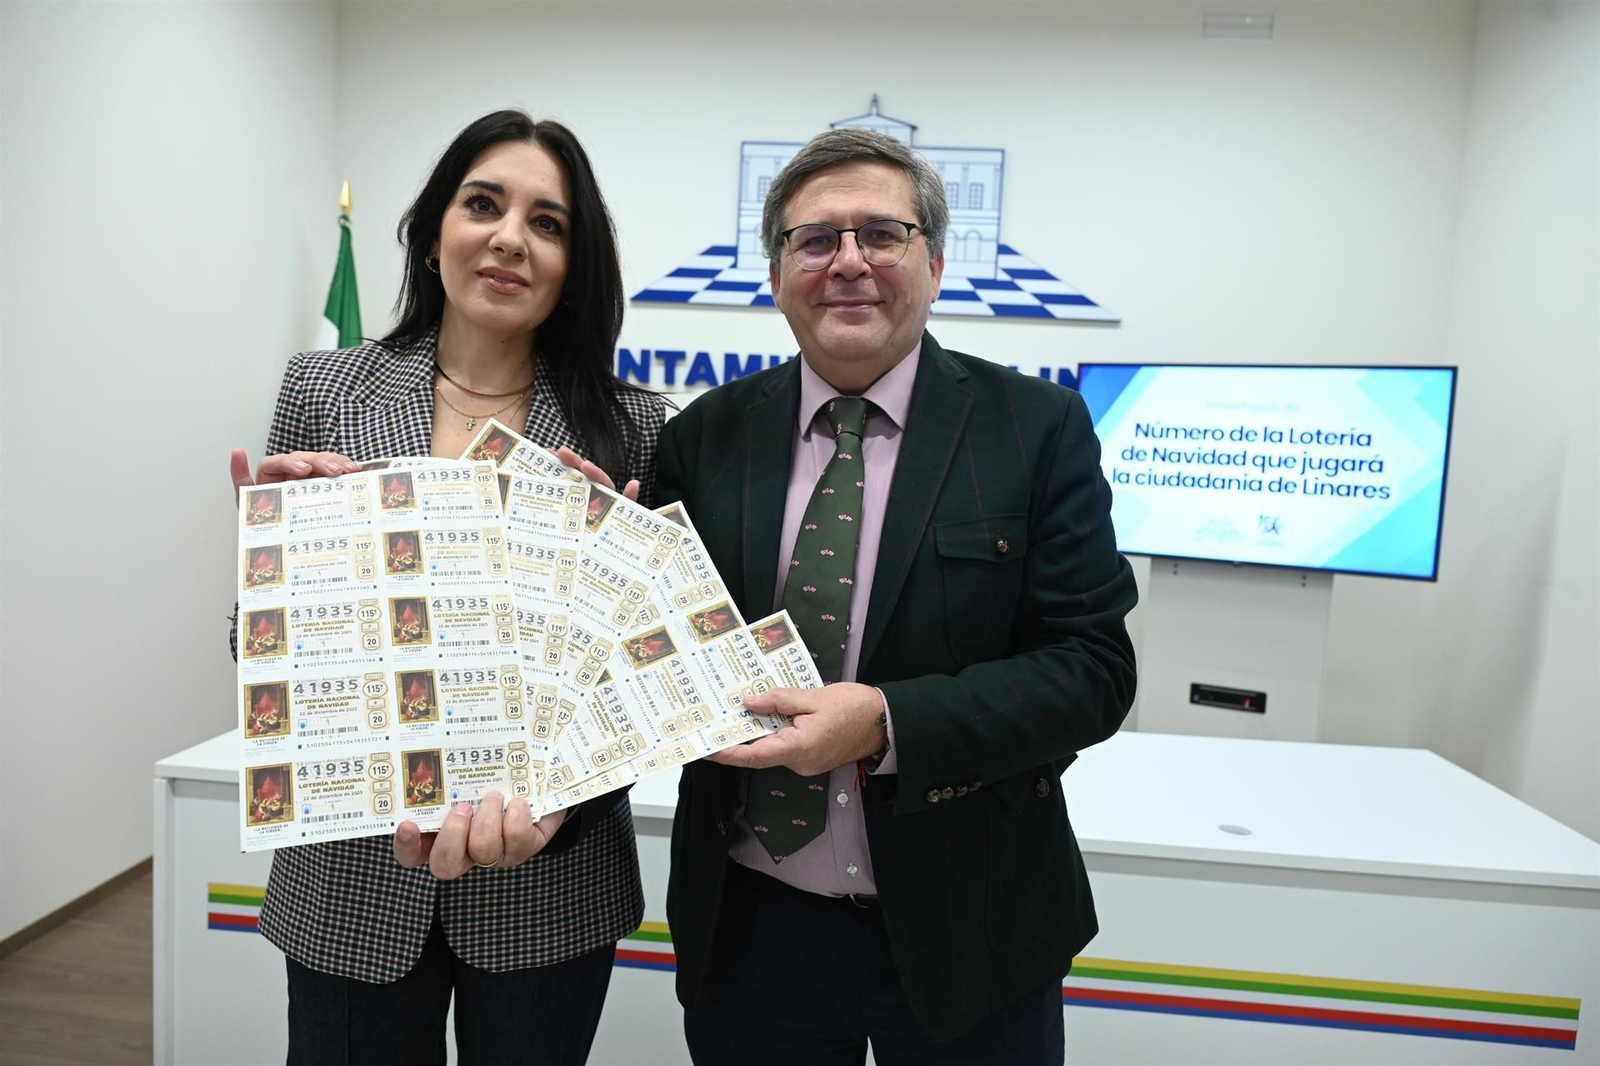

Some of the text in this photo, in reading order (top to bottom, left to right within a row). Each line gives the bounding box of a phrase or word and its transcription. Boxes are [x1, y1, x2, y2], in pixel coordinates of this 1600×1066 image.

[1135, 421, 1372, 446] Número de la Lotería
[518, 447, 563, 476] 41935
[1121, 446, 1384, 477] de Navidad que jugará
[418, 471, 470, 480] 41935
[287, 482, 344, 495] 41935
[515, 481, 564, 497] 41935
[1112, 467, 1130, 484] la
[1268, 477, 1297, 494] de
[1303, 477, 1390, 499] Linares
[617, 506, 661, 533] 41935
[425, 532, 478, 541] 41935
[288, 539, 347, 553] 41935
[683, 537, 710, 579] 41935
[582, 559, 628, 587] 41935
[432, 598, 488, 608] 41935
[680, 596, 687, 604] 20
[291, 605, 352, 618] 41935
[517, 611, 545, 625] 935
[618, 613, 626, 621] 20
[519, 626, 544, 634] ACIONAL
[734, 634, 763, 677] 41935
[440, 671, 496, 683] 41935
[581, 672, 590, 680] 20
[671, 660, 700, 704] 41935
[294, 680, 358, 694] 41935
[733, 696, 740, 704] 20
[604, 687, 633, 733] 41935
[668, 723, 676, 732] 20
[719, 734, 726, 742] 20
[447, 749, 503, 763] 41935
[598, 754, 606, 762] 20
[297, 760, 364, 777] 41935
[648, 760, 655, 768] 20
[572, 789, 580, 797] 20
